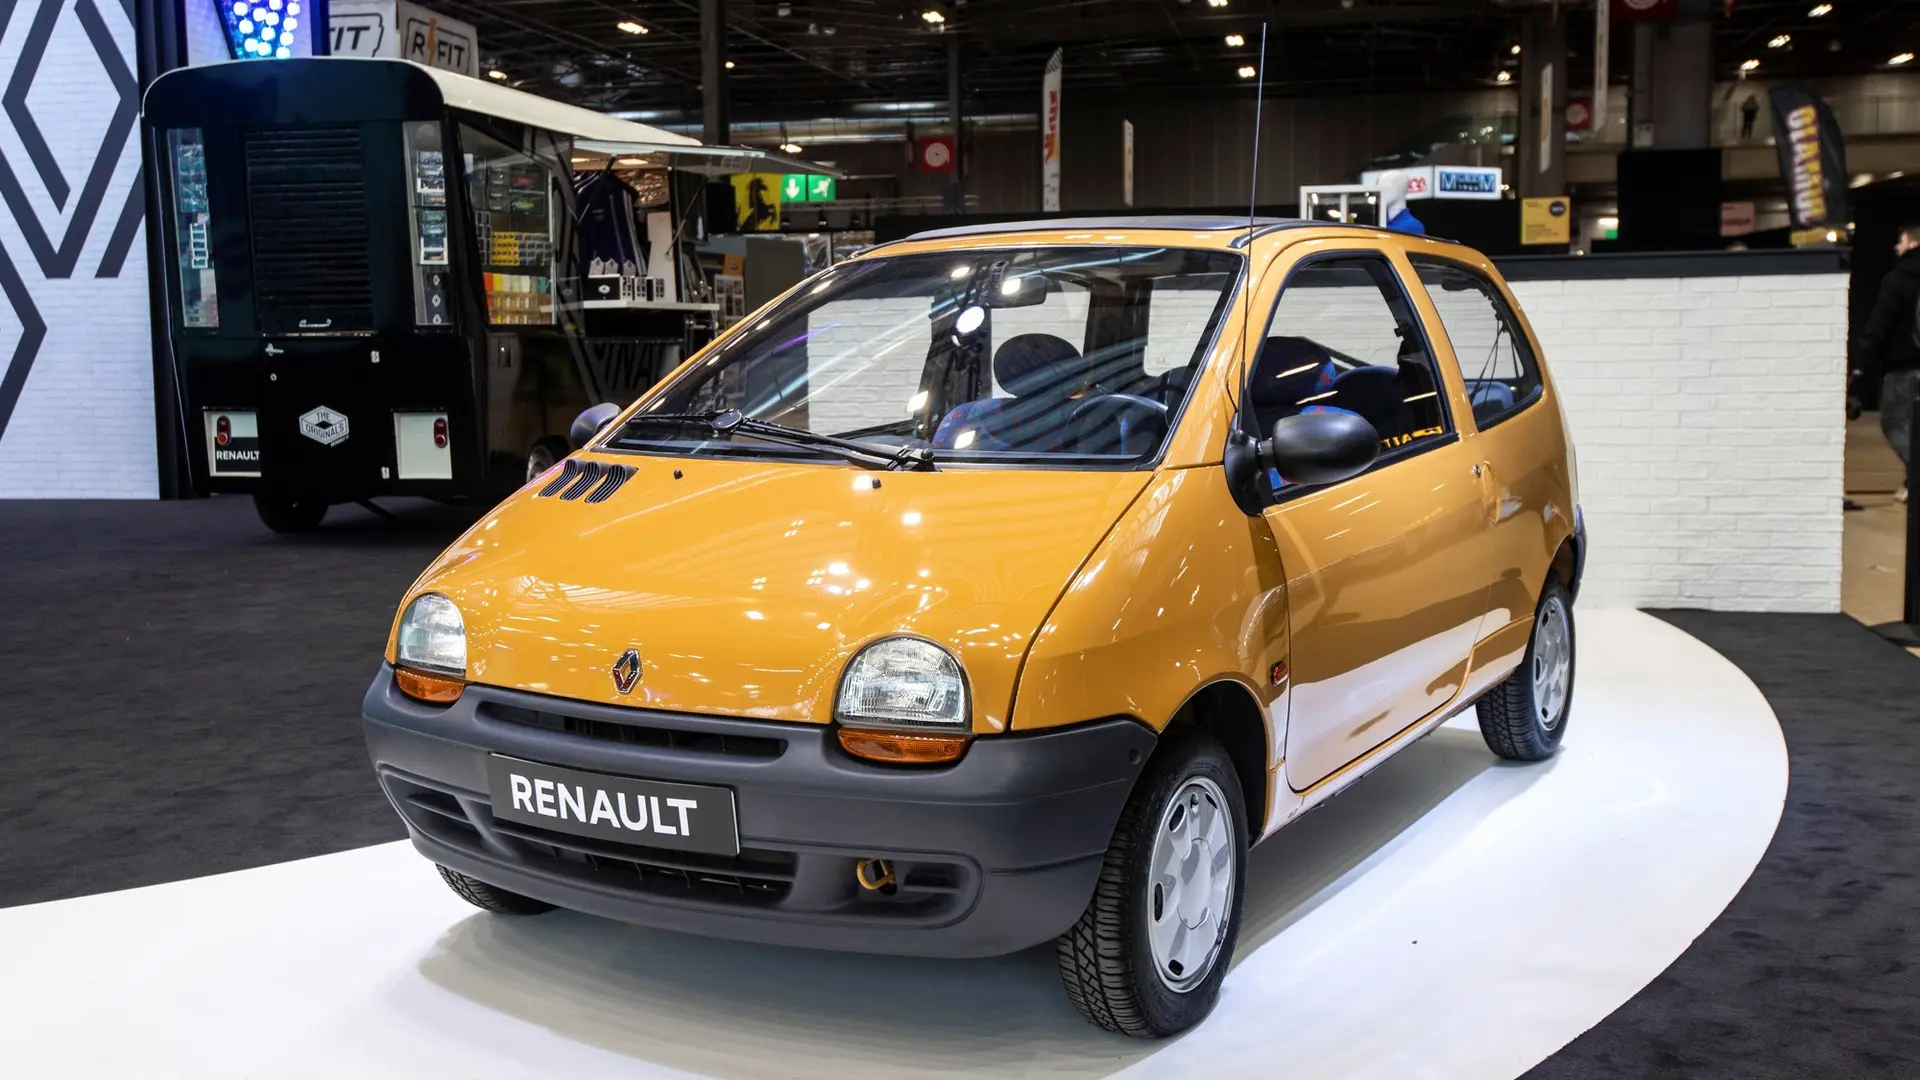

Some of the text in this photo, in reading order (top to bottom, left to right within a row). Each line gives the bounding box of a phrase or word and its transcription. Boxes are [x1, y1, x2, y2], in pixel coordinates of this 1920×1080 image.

[316, 411, 330, 421] THE
[305, 423, 345, 439] ORIGINALS
[216, 451, 260, 460] RENAULT
[510, 773, 697, 836] RENAULT
